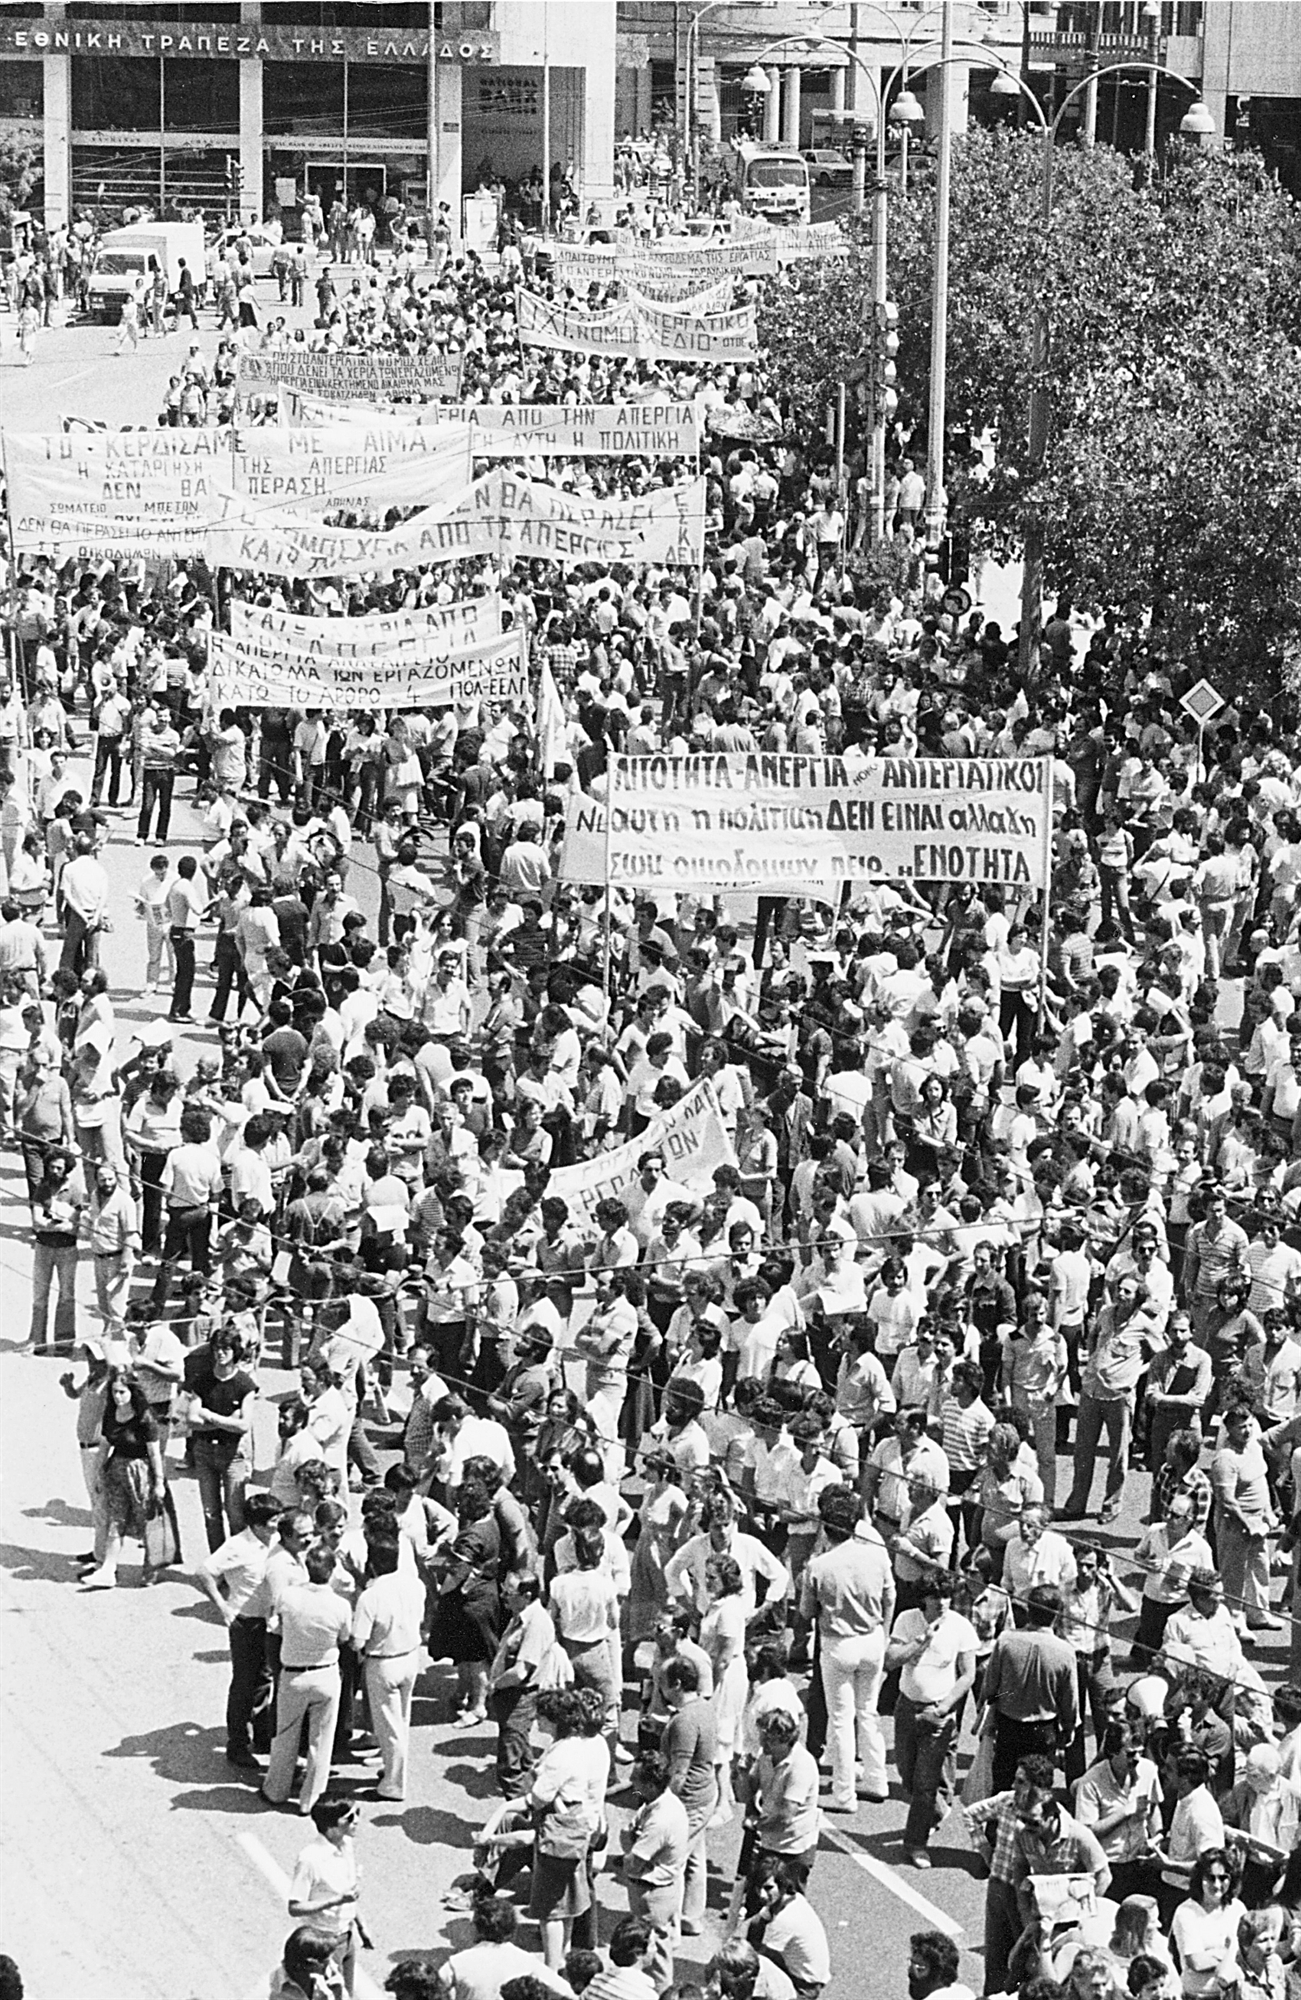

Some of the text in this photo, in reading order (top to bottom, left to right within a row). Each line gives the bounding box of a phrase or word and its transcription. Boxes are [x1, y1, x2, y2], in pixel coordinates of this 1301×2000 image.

[15, 31, 122, 49] ΕΘΝΙΚΗ
[141, 34, 270, 52] ΤΡΑΠΕΖΑ
[292, 39, 344, 54] ΤΗΣ
[273, 362, 296, 376] ΠΟΥ
[297, 364, 328, 378] ΔΕΝΕΙ
[331, 366, 344, 379] ΤΑ
[346, 366, 377, 380] ΧΕΡΙΑ
[423, 377, 446, 387] ΜΑΣ
[502, 408, 543, 427] ΑΠΟ
[561, 407, 596, 426] ΤΗΝ
[616, 405, 694, 426] ΑΠΕΡΓΙΑ
[289, 430, 323, 454] ΜΕ
[513, 432, 557, 449] ΑΥΤΗ
[573, 431, 584, 447] Η
[599, 431, 680, 450] ΠΟΛΙΤΙΚΗ
[78, 455, 388, 480] Η ΚΑΤΑΡΓΗΣΗ ΤΗΣ ΑΠΕΡΓΙΑΣ
[102, 481, 141, 500] ΔΕΝ
[50, 503, 107, 514] ΣΩΜΑΤΕΙΟ
[18, 517, 45, 533] ΔΕΝ
[51, 520, 71, 535] ΘΑ
[419, 519, 470, 550] ΑΠΟ
[426, 604, 478, 633] ΑΠΟ
[211, 635, 224, 653] Η
[211, 658, 321, 681] ΔΙΚΑΙΩΜΑ
[374, 655, 521, 684] ΕΡΓΑΖΟΜΕΝΩΝ
[217, 683, 271, 702] ΚΑΤΩ
[289, 684, 310, 704] ΤΟ
[318, 686, 381, 705] ΑΡΘΡΟ
[406, 684, 421, 704] 4
[881, 758, 1043, 794] ΑΝΤΕΡΓΑΤΙΚΟΙ
[690, 808, 711, 831] η
[826, 799, 875, 832] ΔΕΝ
[880, 801, 945, 832] ΕΙΝΑΙ
[913, 844, 1031, 882] ΕΝΟΤΗΤΑ
